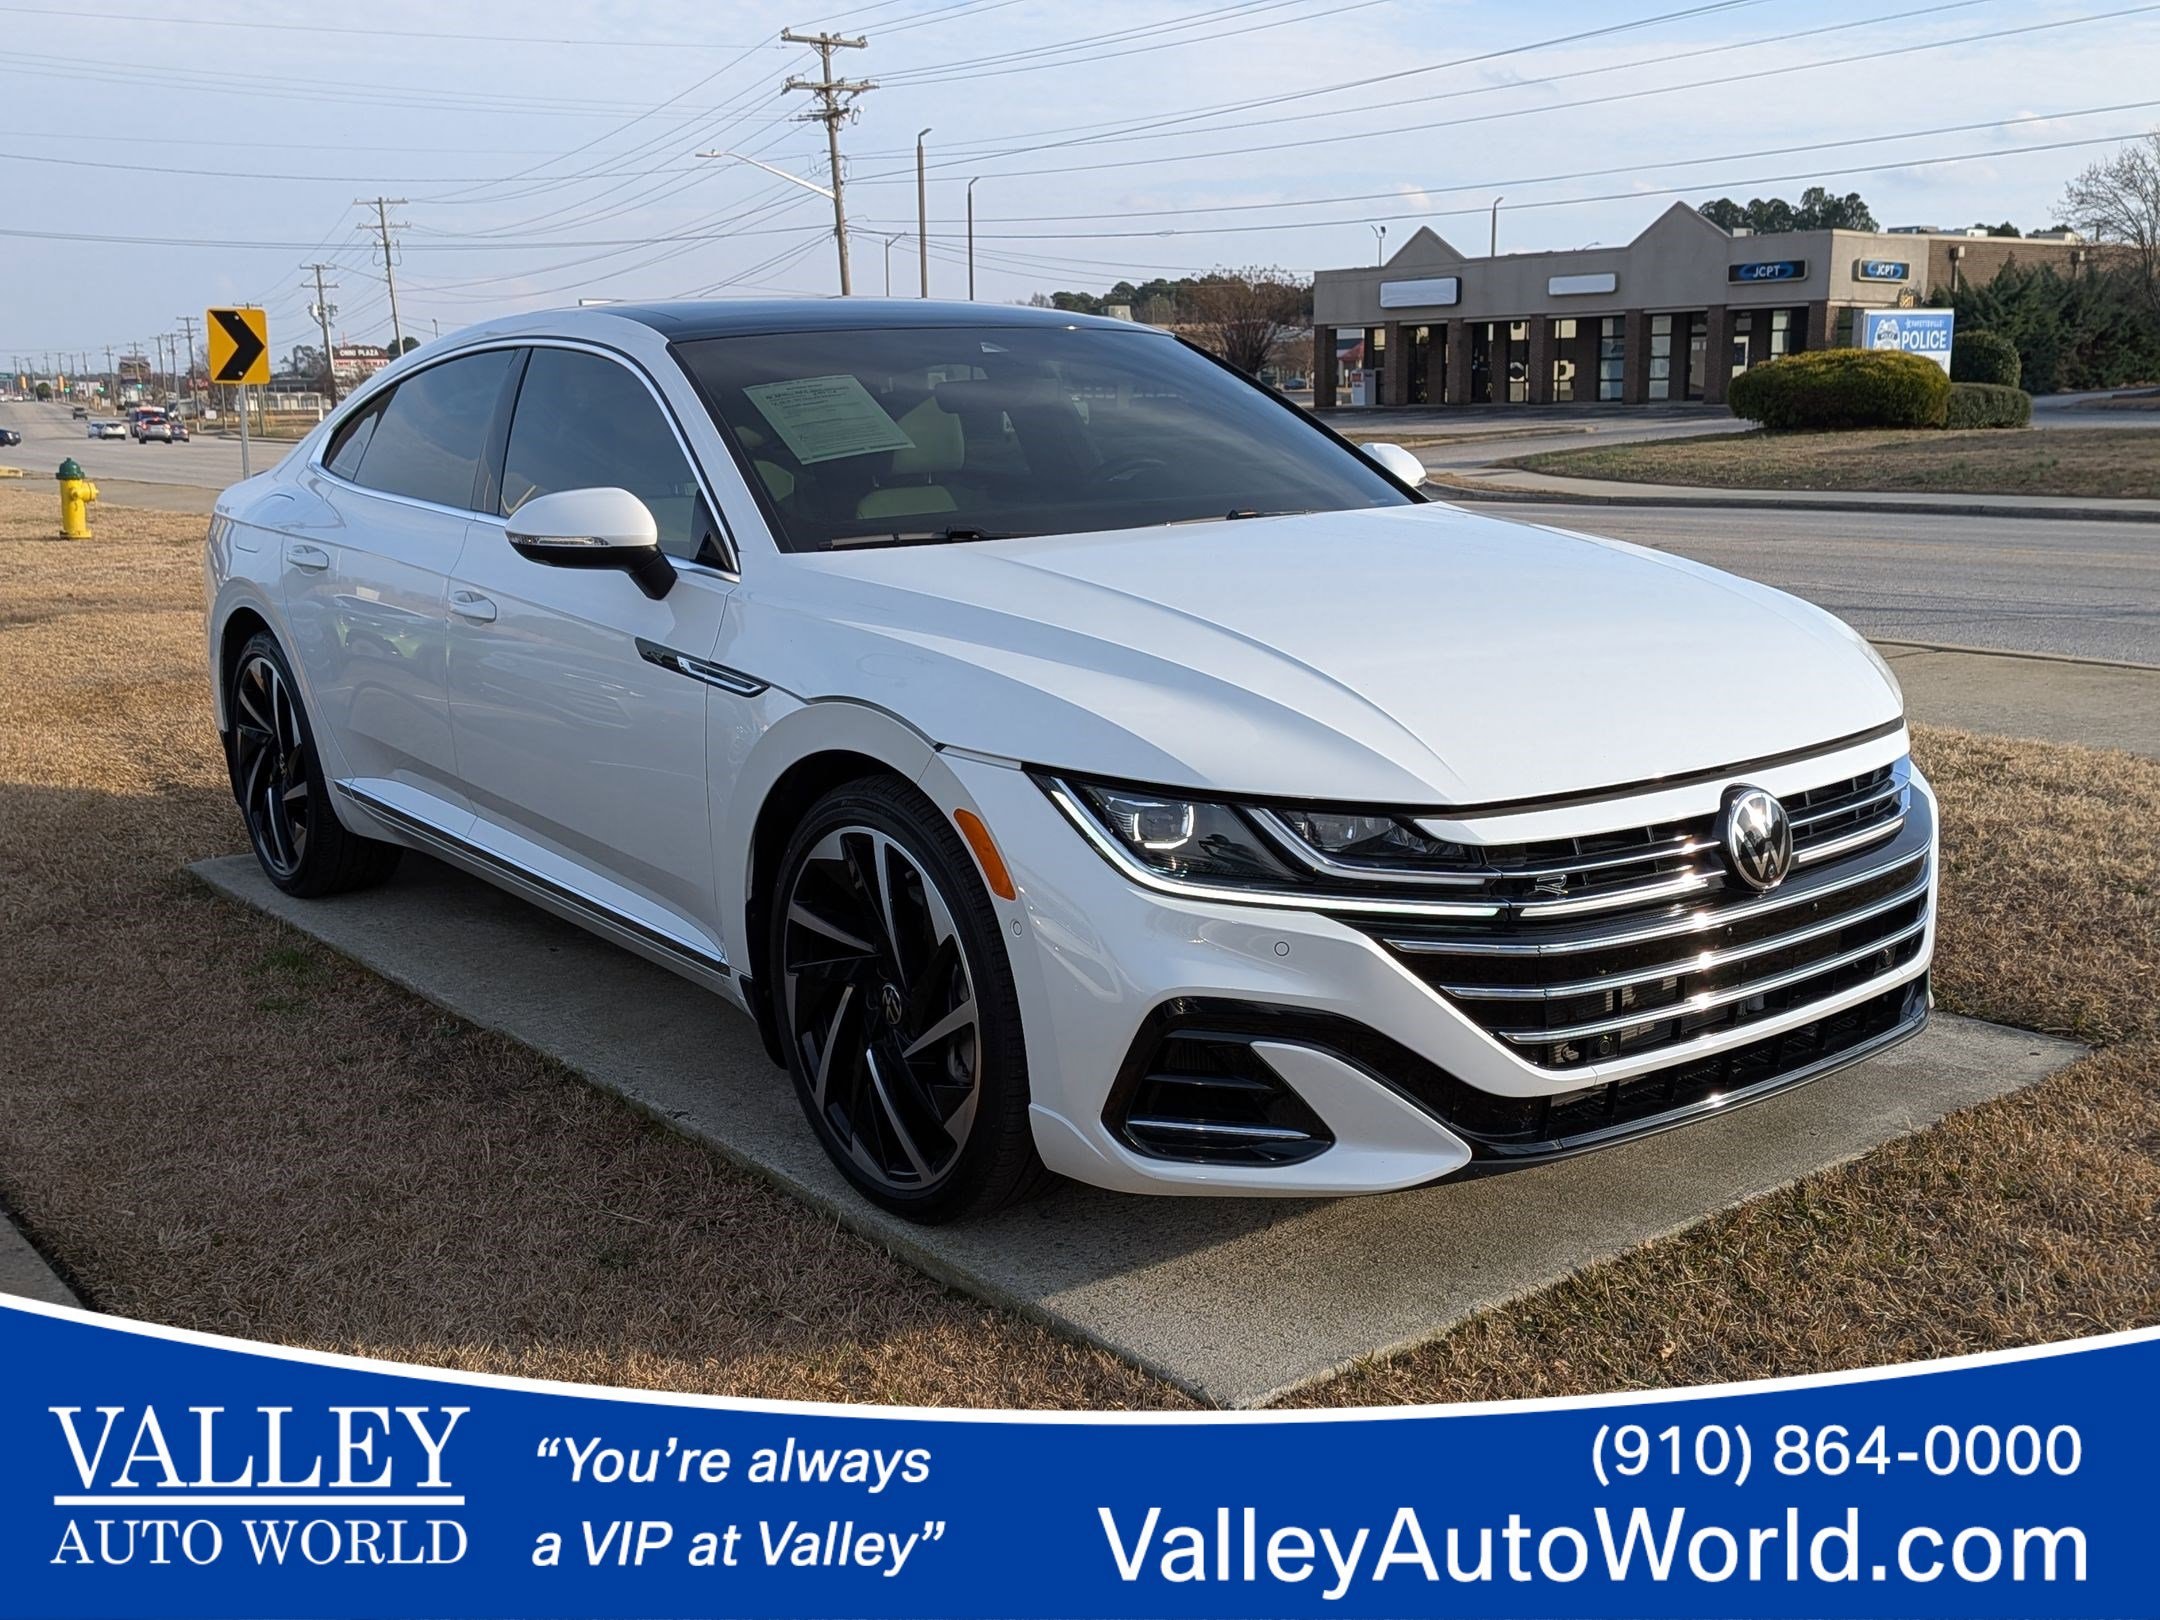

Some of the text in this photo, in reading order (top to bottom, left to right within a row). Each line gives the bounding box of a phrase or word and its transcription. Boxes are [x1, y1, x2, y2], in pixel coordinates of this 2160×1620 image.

[1752, 264, 1780, 278] JCPT
[1875, 263, 1895, 277] JCPT
[1901, 330, 1947, 350] POLICE
[358, 348, 379, 357] PLAZA
